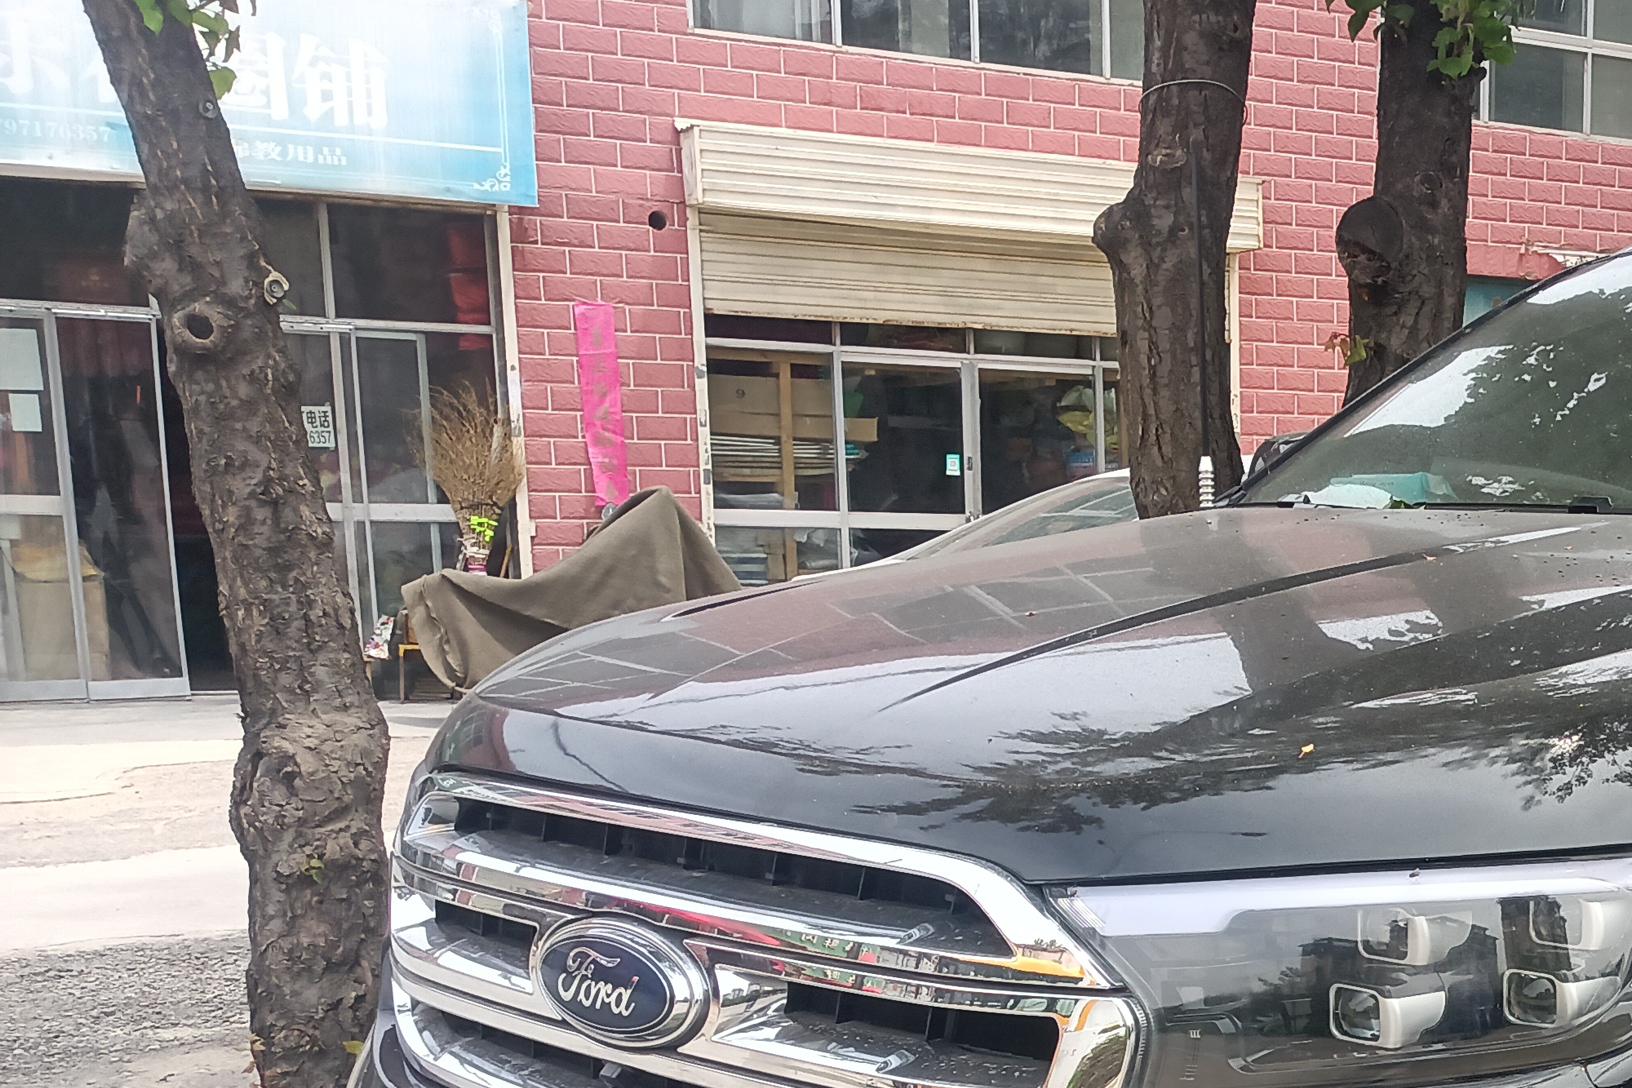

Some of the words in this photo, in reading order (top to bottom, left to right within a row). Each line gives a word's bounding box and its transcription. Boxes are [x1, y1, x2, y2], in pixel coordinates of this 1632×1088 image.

[0, 118, 110, 143] 97176357
[301, 410, 330, 429] 电话
[557, 946, 639, 1017] Ford
